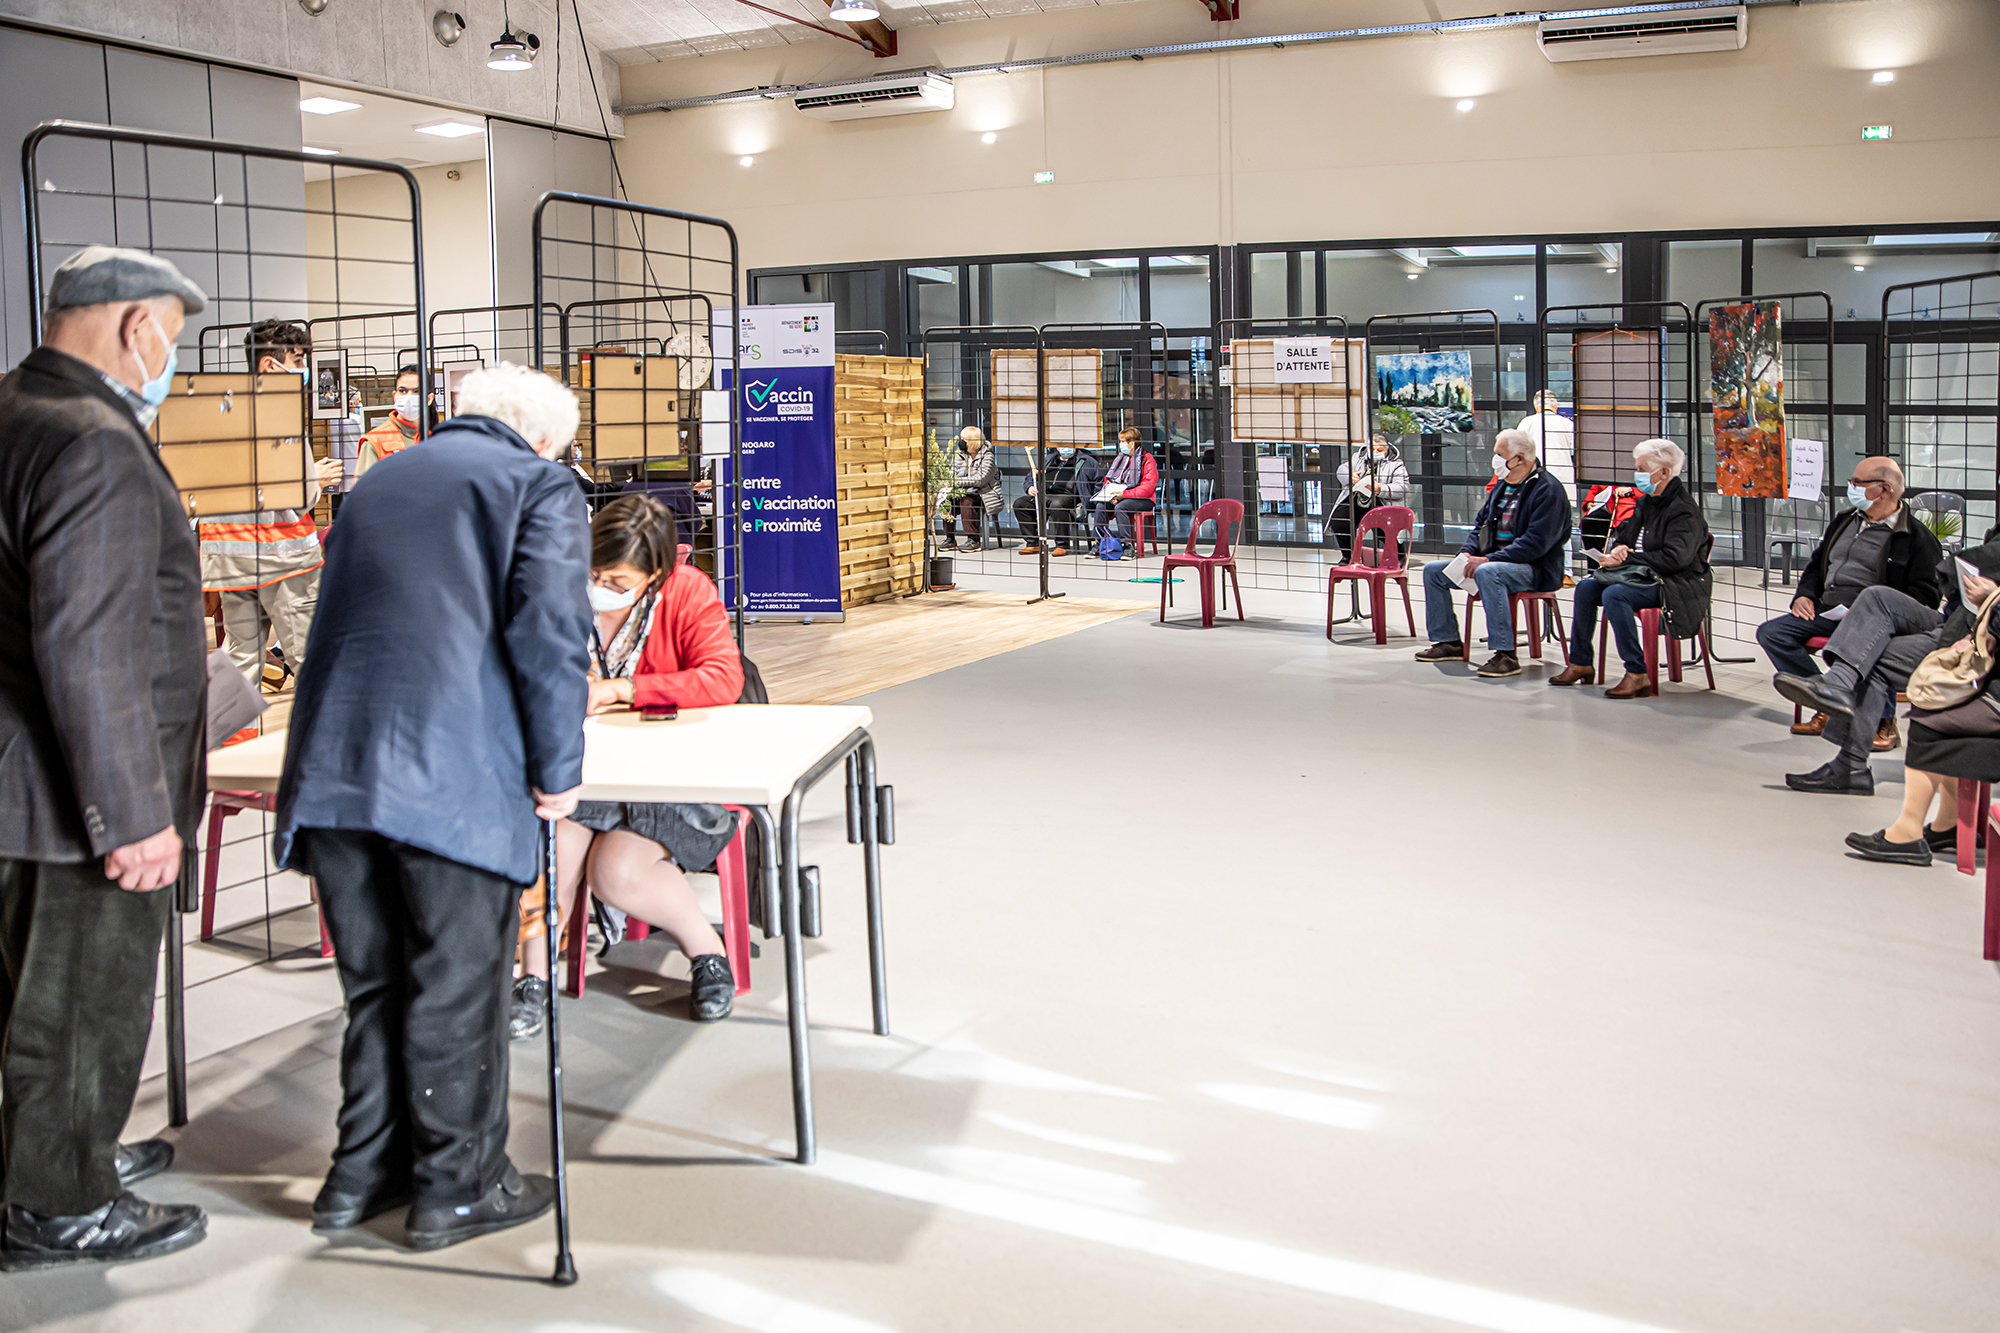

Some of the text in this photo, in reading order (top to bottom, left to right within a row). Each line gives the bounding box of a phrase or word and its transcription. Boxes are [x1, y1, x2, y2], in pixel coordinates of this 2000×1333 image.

[1286, 348, 1318, 357] SALLE
[1276, 362, 1330, 371] D'ATTENTE
[752, 495, 836, 510] Vaccination
[755, 517, 822, 532] Proximité
